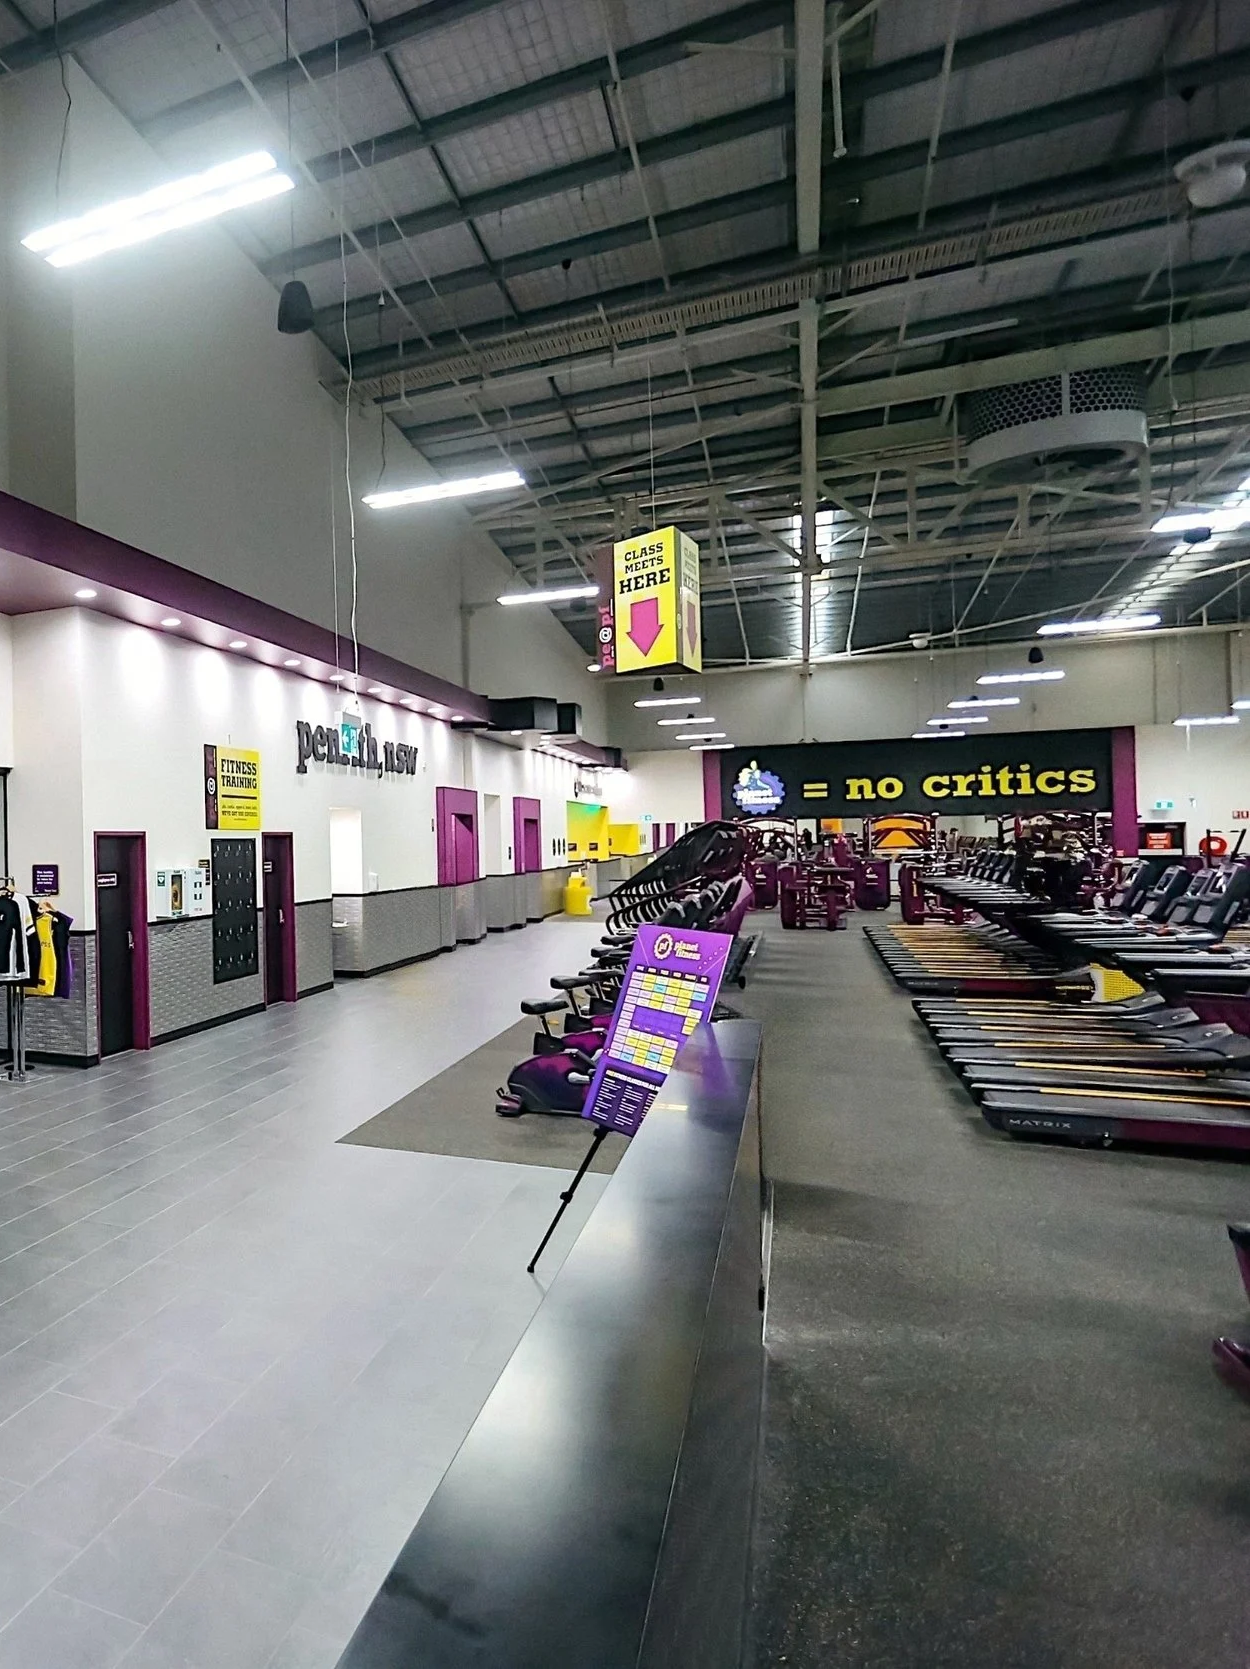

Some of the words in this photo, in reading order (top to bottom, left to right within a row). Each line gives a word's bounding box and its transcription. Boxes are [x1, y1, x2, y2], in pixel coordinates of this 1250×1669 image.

[624, 542, 664, 562] CLASS
[624, 555, 664, 574] MEETS
[619, 568, 670, 594] HERE
[297, 720, 383, 778] penth,
[383, 741, 418, 775] nsw
[221, 759, 257, 775] FITNESS
[221, 775, 257, 789] TRAINING
[846, 777, 903, 799] no
[922, 763, 1096, 797] critics
[673, 941, 699, 952] planet
[675, 948, 701, 960] fitness
[1010, 1119, 1071, 1128] MATRIX
